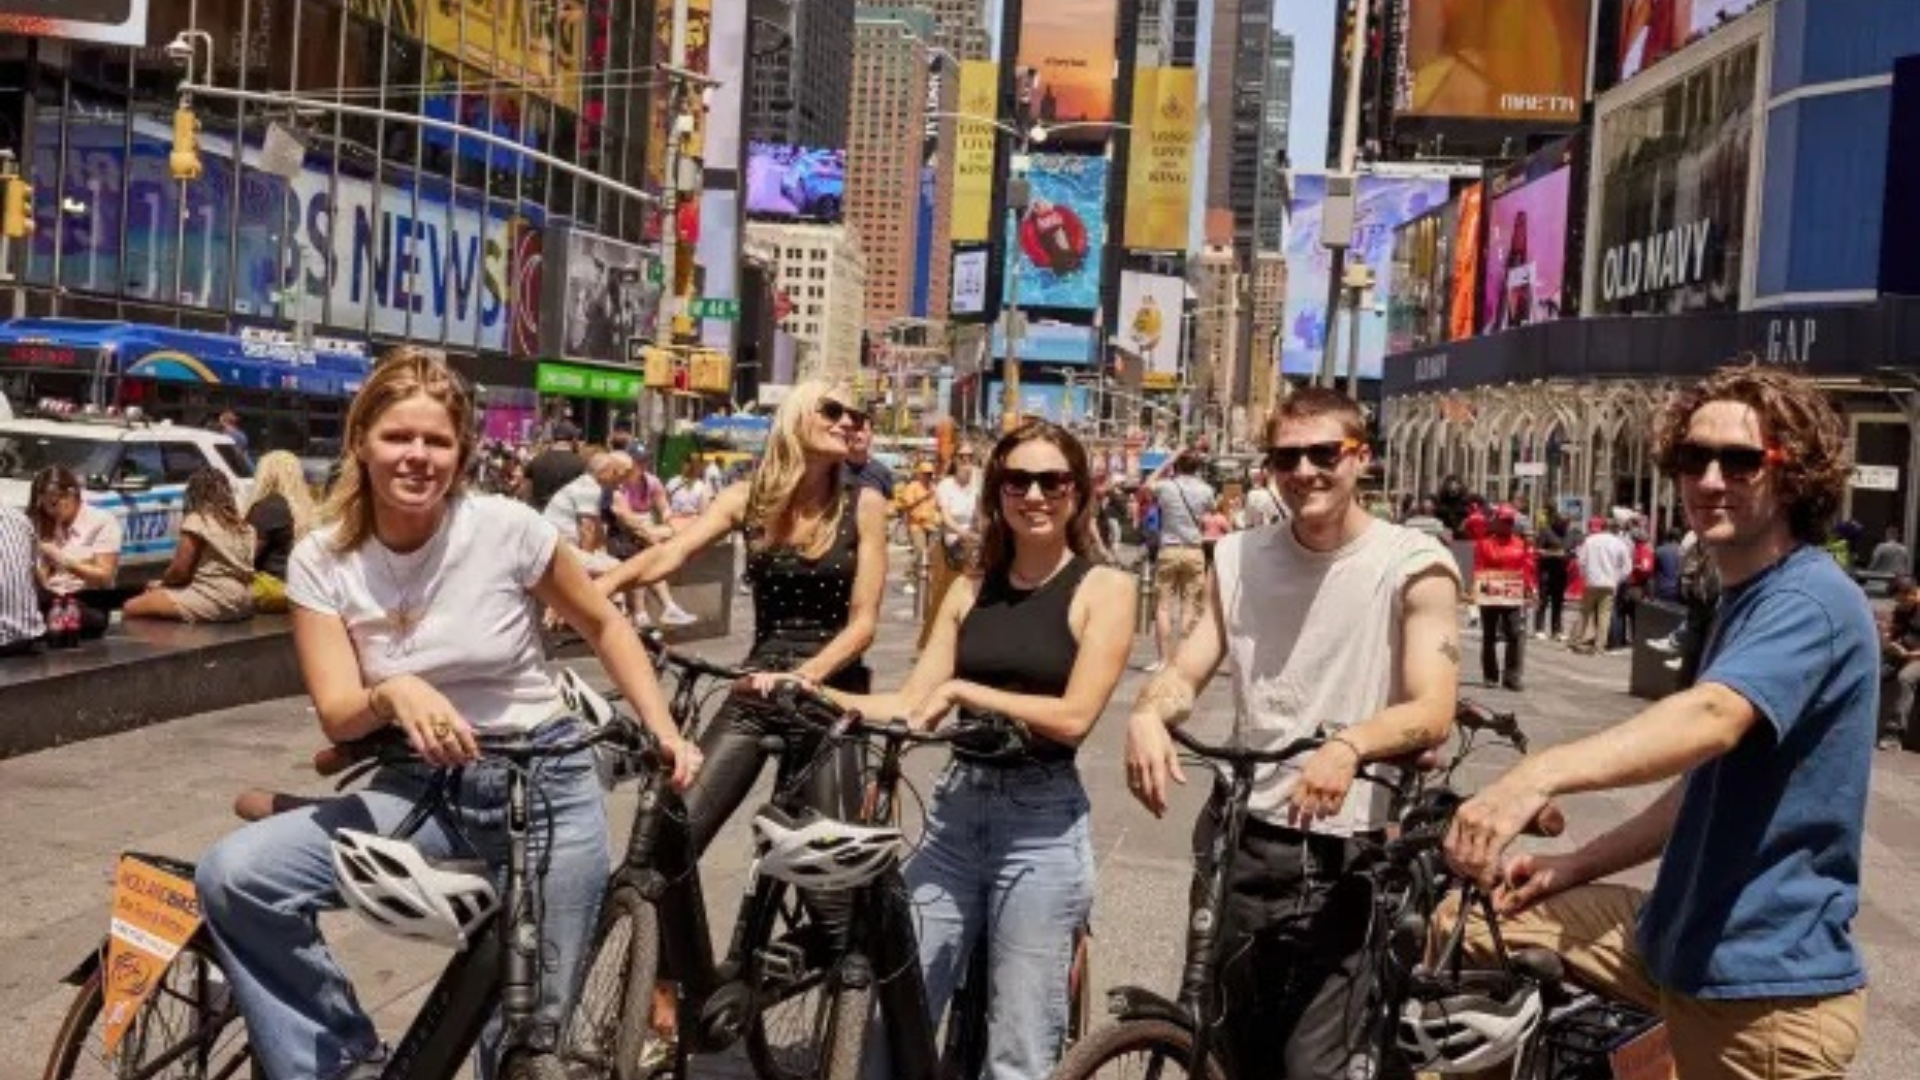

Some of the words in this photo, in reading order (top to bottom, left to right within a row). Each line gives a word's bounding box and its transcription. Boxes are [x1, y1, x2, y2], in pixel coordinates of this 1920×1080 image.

[1149, 172, 1186, 184] KING
[352, 205, 503, 326] NEWS
[1603, 240, 1642, 301] OLD
[1644, 217, 1710, 292] NAVY
[1766, 318, 1816, 363] GAP
